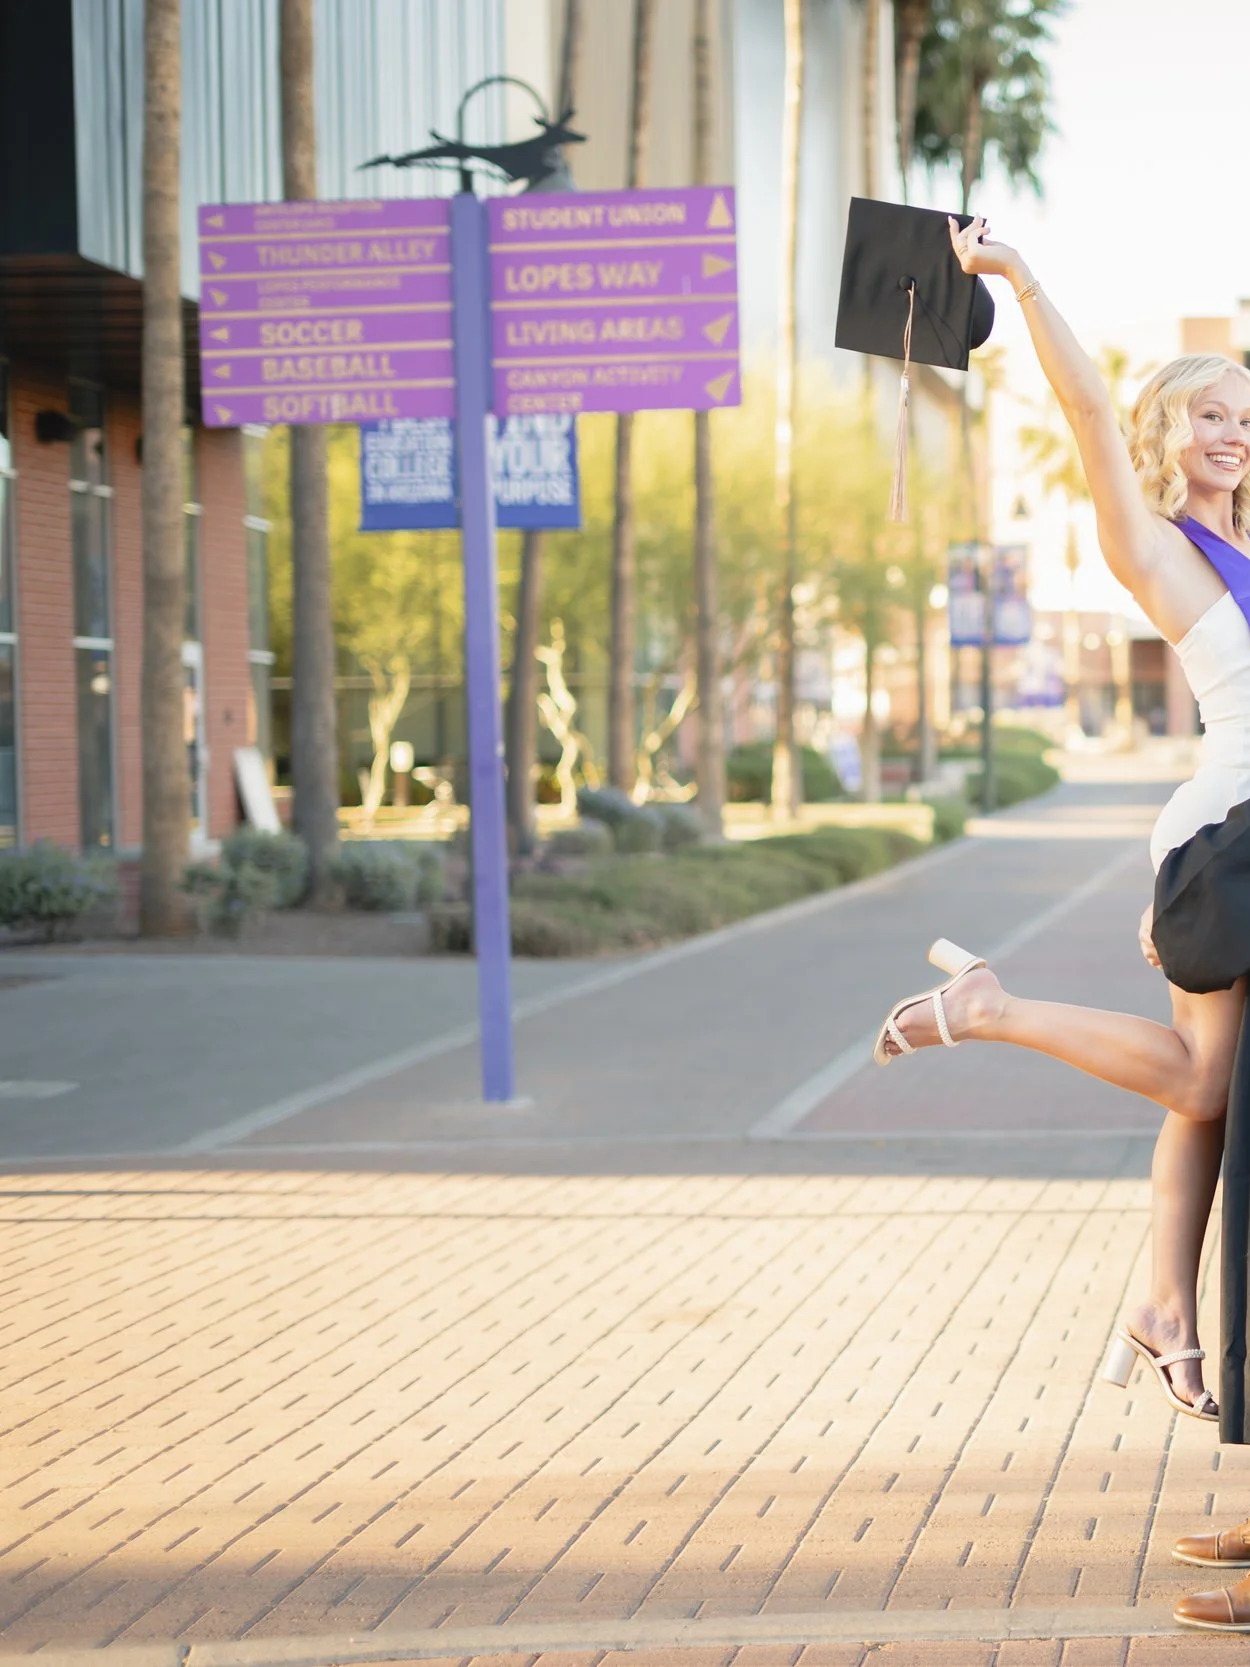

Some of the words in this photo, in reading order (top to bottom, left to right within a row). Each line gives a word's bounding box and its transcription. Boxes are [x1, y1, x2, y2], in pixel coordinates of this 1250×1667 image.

[503, 205, 604, 231] STUDENT
[609, 203, 686, 227] UNION
[257, 243, 363, 266] THUNDER
[368, 239, 437, 261] ALLEY
[505, 262, 594, 292] LOPES
[598, 259, 663, 289] WAY
[260, 319, 363, 346] SOCCER
[506, 320, 596, 346] LIVING
[600, 316, 685, 341] AREAS
[262, 354, 395, 381] BASEBALL
[263, 392, 398, 419] SOFTBALL
